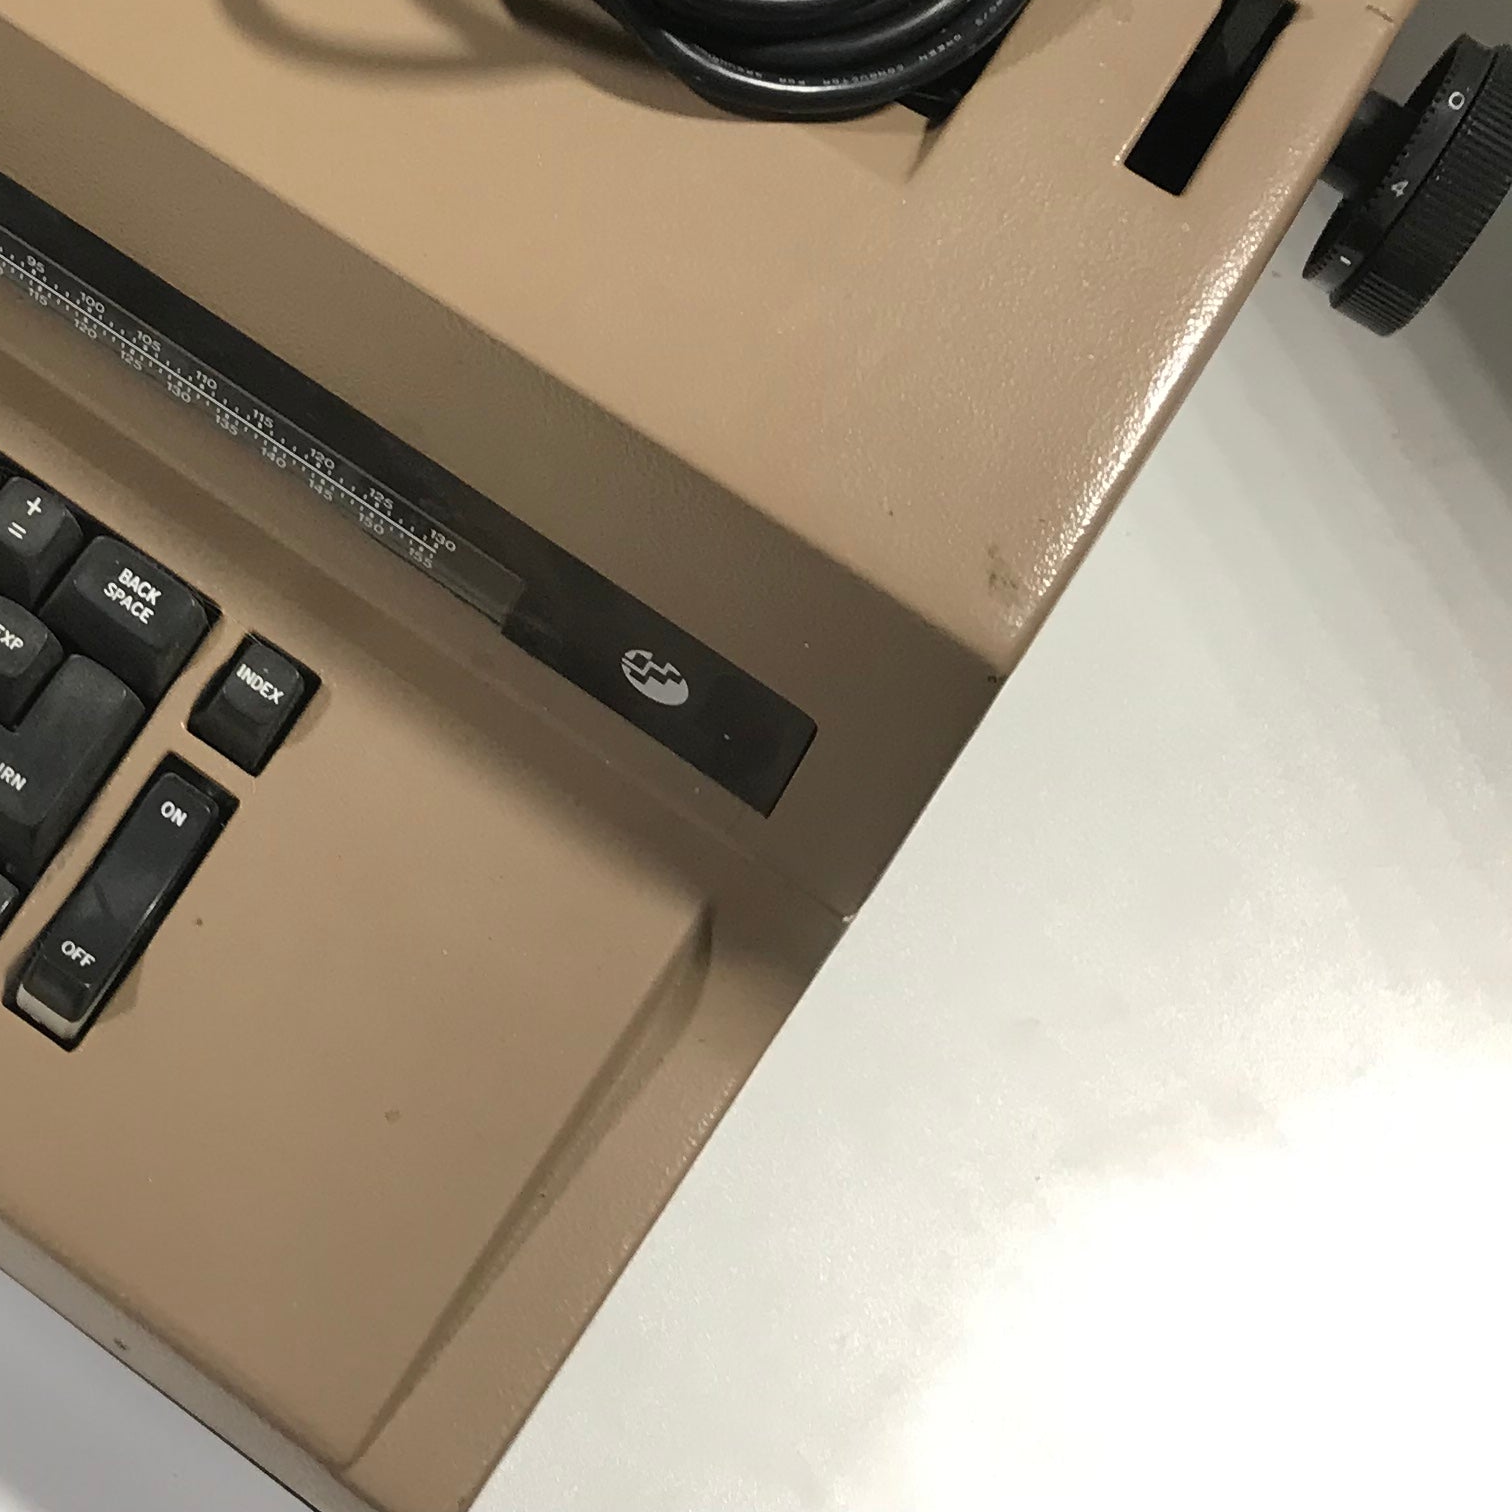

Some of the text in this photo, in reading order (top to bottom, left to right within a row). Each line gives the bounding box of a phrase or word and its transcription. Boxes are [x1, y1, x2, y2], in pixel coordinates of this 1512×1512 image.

[27, 255, 45, 274] 95
[81, 292, 105, 314] 100
[137, 330, 161, 352] 105
[196, 370, 218, 390] 110
[253, 409, 274, 429] 115
[310, 448, 335, 470] 120
[369, 487, 394, 510] 125
[430, 529, 457, 552] 130
[28, 287, 48, 306] 115
[73, 318, 98, 339] 120
[120, 350, 143, 371] 125
[166, 381, 192, 403] 130
[215, 414, 238, 436] 135
[261, 446, 287, 469] 140
[308, 478, 333, 502] 145
[359, 512, 385, 535] 150
[408, 547, 433, 569] 155
[27, 498, 41, 515] +
[8, 522, 26, 539] =
[104, 579, 158, 624] SPACE
[119, 568, 161, 609] BACK
[237, 664, 284, 704] INDEX
[161, 801, 187, 826] ON
[62, 941, 95, 966] OFF
